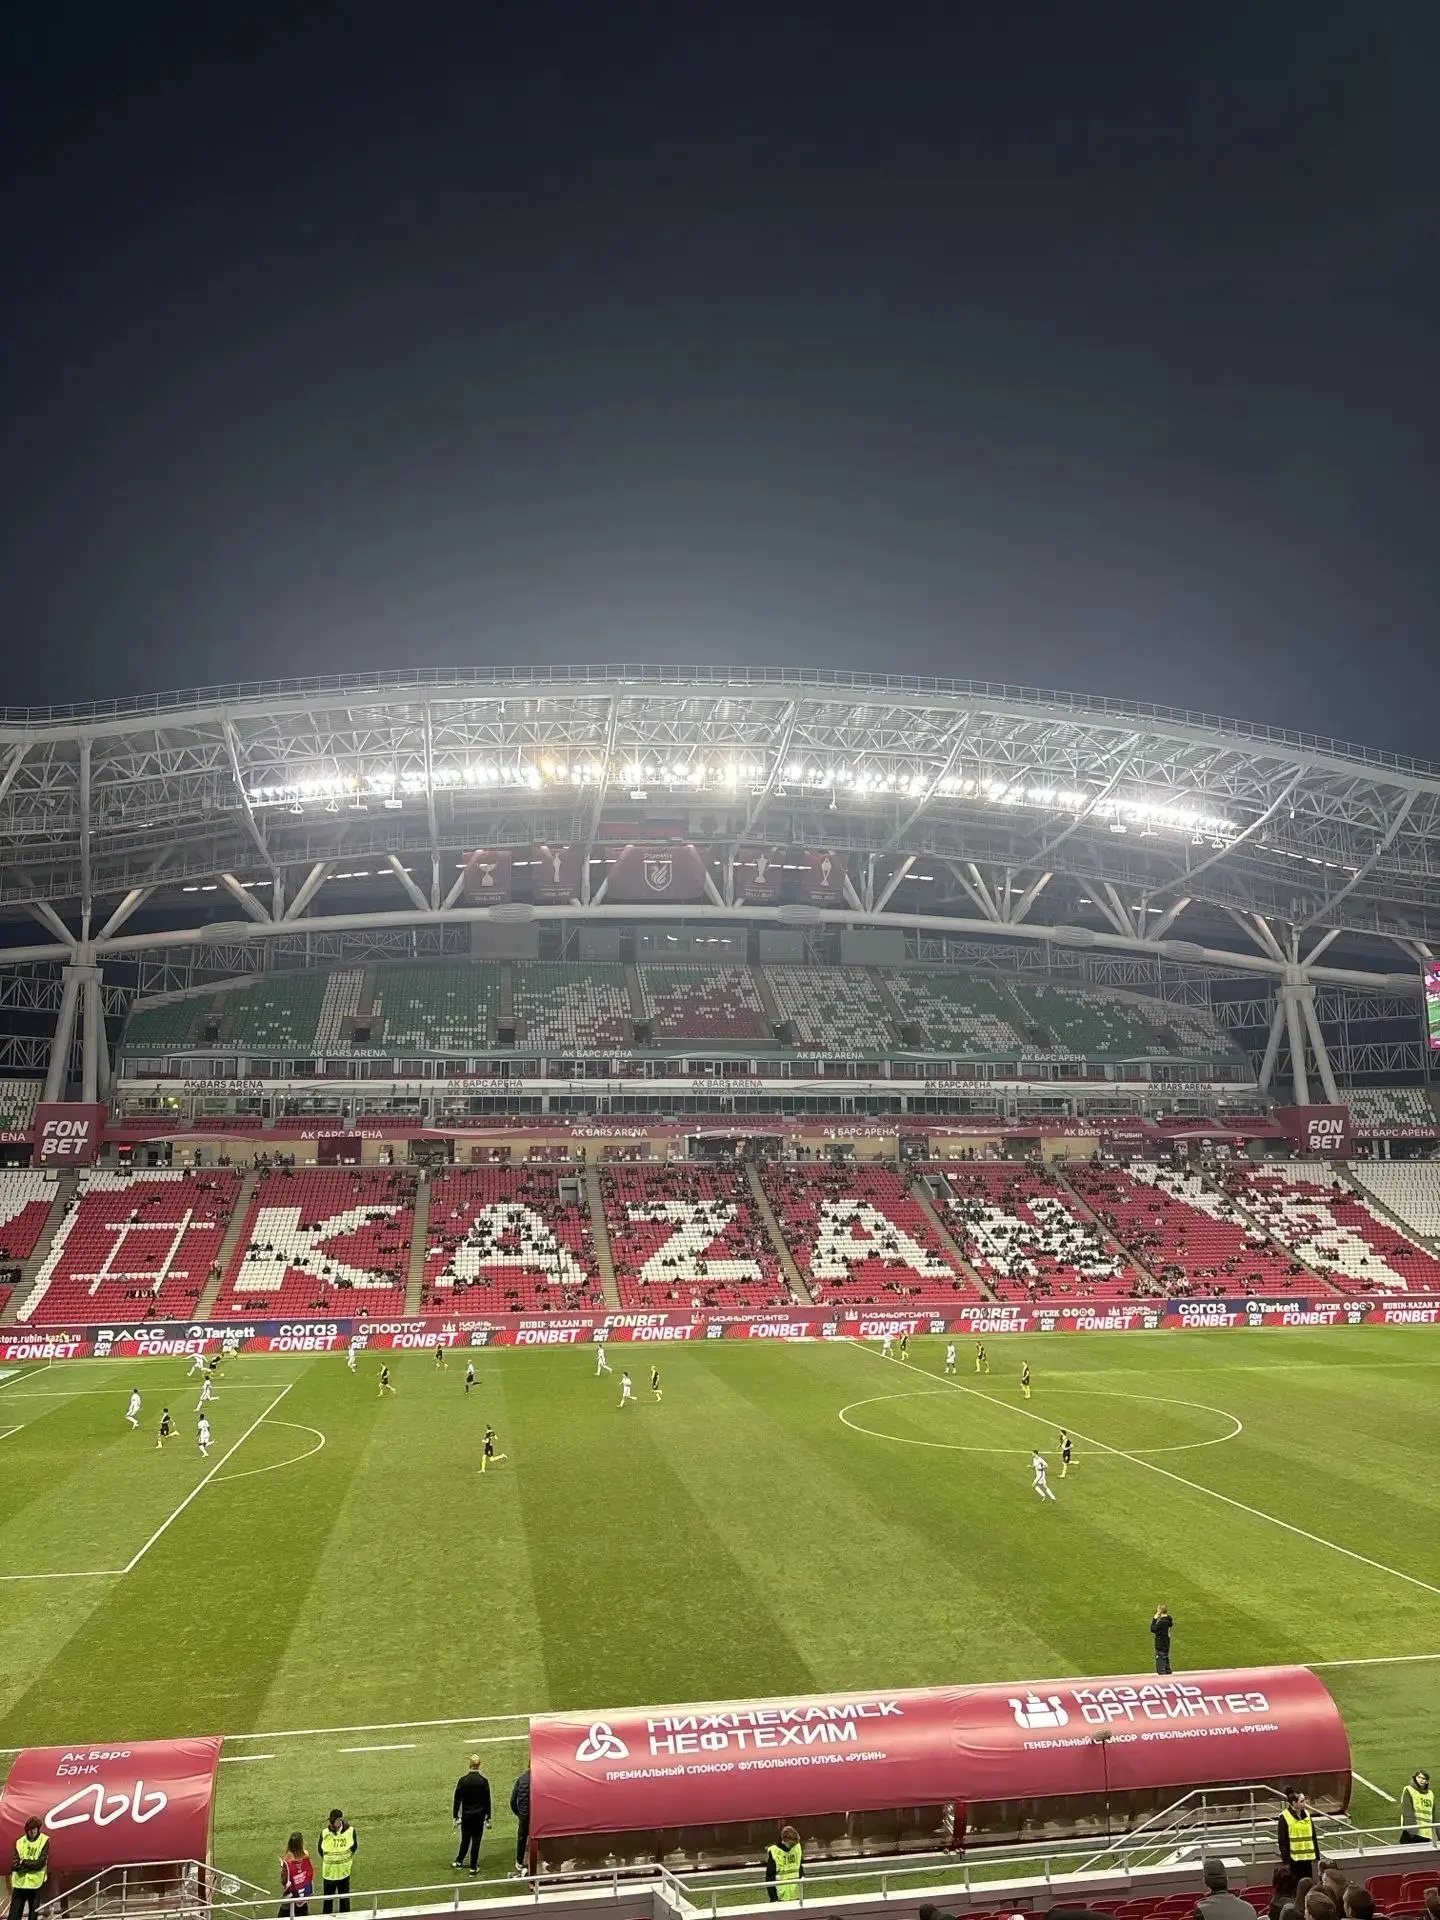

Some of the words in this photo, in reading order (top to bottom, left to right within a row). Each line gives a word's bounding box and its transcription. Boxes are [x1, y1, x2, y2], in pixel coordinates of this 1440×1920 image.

[310, 1049, 324, 1057] AK
[326, 1049, 352, 1057] BARS
[353, 1049, 387, 1057] ARENA
[184, 1080, 199, 1089] AK
[201, 1080, 226, 1089] BARS
[229, 1080, 264, 1089] ARENA
[447, 1080, 460, 1088] АК
[463, 1080, 489, 1088] БАРС
[490, 1080, 523, 1088] АРЕНА
[692, 1080, 705, 1088] AK
[707, 1080, 730, 1088] BARS
[733, 1080, 763, 1088] ARENA
[925, 1081, 936, 1089] АК
[939, 1081, 961, 1089] БАРС
[963, 1081, 992, 1089] АРЕНА
[1148, 1083, 1159, 1091] AK
[1161, 1083, 1182, 1091] BARS
[1185, 1083, 1212, 1091] ARENA
[42, 1121, 89, 1136] FON
[571, 1128, 586, 1136] AK
[587, 1128, 612, 1136] BARS
[615, 1128, 648, 1136] ARENA
[824, 1128, 836, 1136] АК
[838, 1128, 862, 1136] БАРС
[865, 1128, 895, 1136] АРЕНА
[1308, 1120, 1343, 1133] FON
[1357, 1129, 1371, 1137] АК
[1372, 1129, 1399, 1137] БАРС
[1401, 1129, 1435, 1137] АРЕНА
[42, 1139, 88, 1154] BET
[1309, 1135, 1344, 1149] BET
[1259, 1303, 1299, 1312] Tarkett
[604, 1314, 669, 1328] FONBET
[1076, 1316, 1133, 1329] FONBET
[1182, 1314, 1237, 1327] FONBET
[1283, 1311, 1337, 1325] FONBET
[1385, 1310, 1438, 1323] FONBET
[280, 1324, 337, 1336] согаз
[750, 1323, 810, 1337] FONBET
[860, 1321, 918, 1334] FONBET
[971, 1319, 1028, 1332] FONBET
[205, 1327, 255, 1338] Tarkett
[515, 1329, 580, 1344] FONBET
[632, 1326, 695, 1340] FONBET
[269, 1336, 337, 1351] FONBET
[392, 1332, 459, 1347] FONBET
[5, 1343, 79, 1359] FONBET
[137, 1339, 209, 1355] FONBET
[1070, 1683, 1201, 1704] КАЗАНЬ
[1081, 1693, 1270, 1724] ОРГСИНТЕЗ
[646, 1701, 904, 1733] НИЖНЕКАМСК
[650, 1722, 858, 1756] НЕФТЕХИМ
[1023, 1736, 1092, 1750] ГЕНЕРАЛЬНЫЙ
[1093, 1733, 1137, 1744] ОНСОР
[1141, 1728, 1207, 1741] ФУТБОЛЬНОГО
[1209, 1726, 1239, 1736] КЛУБА
[61, 1752, 85, 1762] Ак
[88, 1750, 131, 1760] Барс
[56, 1764, 100, 1776] Банк
[606, 1764, 684, 1781] ПРЕМИАЛЬНЫЙ
[687, 1762, 734, 1775] СПОНСОР
[738, 1757, 809, 1770] ФУТБОЛЬНОГО
[811, 1754, 843, 1765] КЛУБА
[846, 1751, 886, 1763] «РУБИН»
